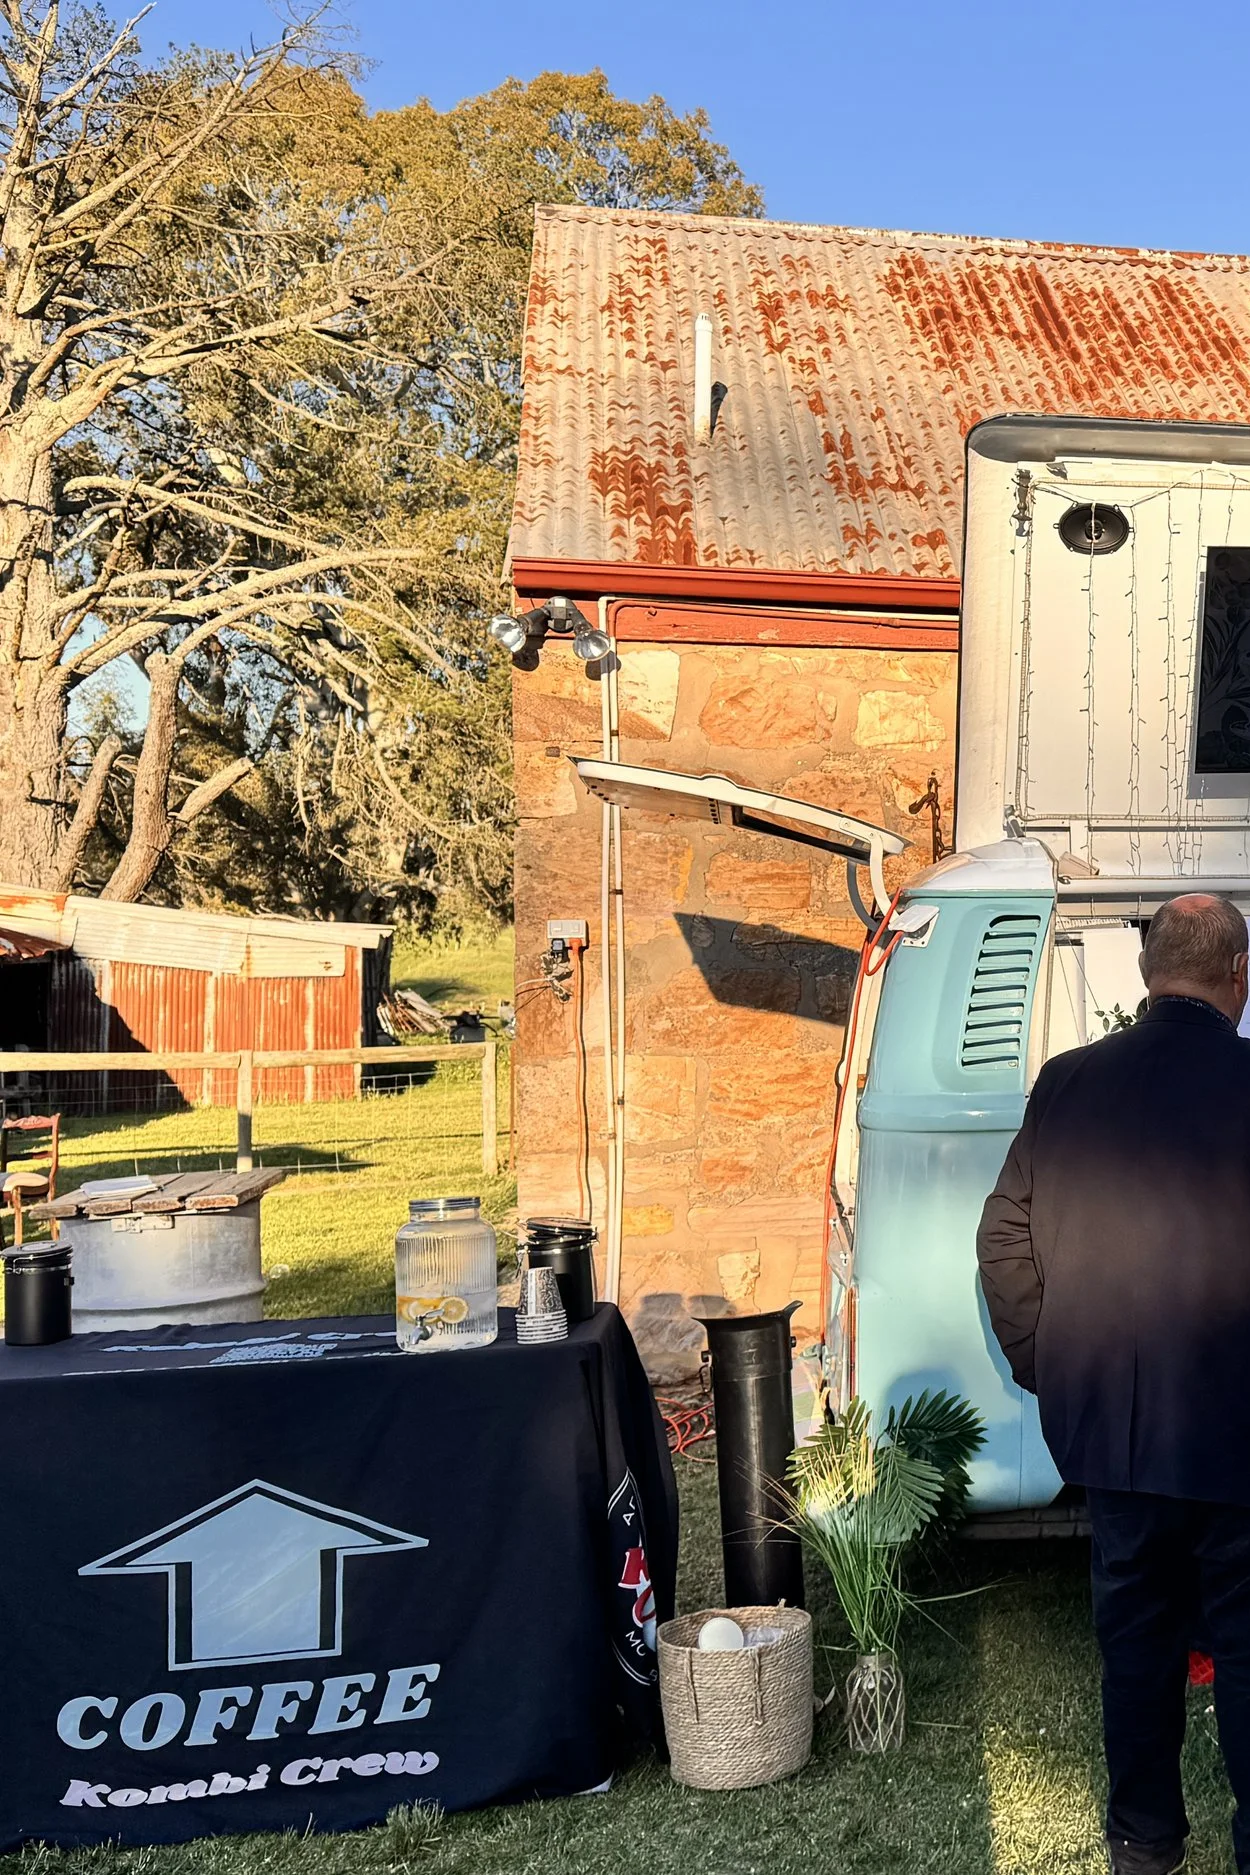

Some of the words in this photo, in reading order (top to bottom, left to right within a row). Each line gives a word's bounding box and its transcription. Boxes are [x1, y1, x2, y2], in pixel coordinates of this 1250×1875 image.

[56, 1663, 441, 1751] COFFEE
[59, 1764, 271, 1808] Kombi
[279, 1750, 441, 1786] Crew
